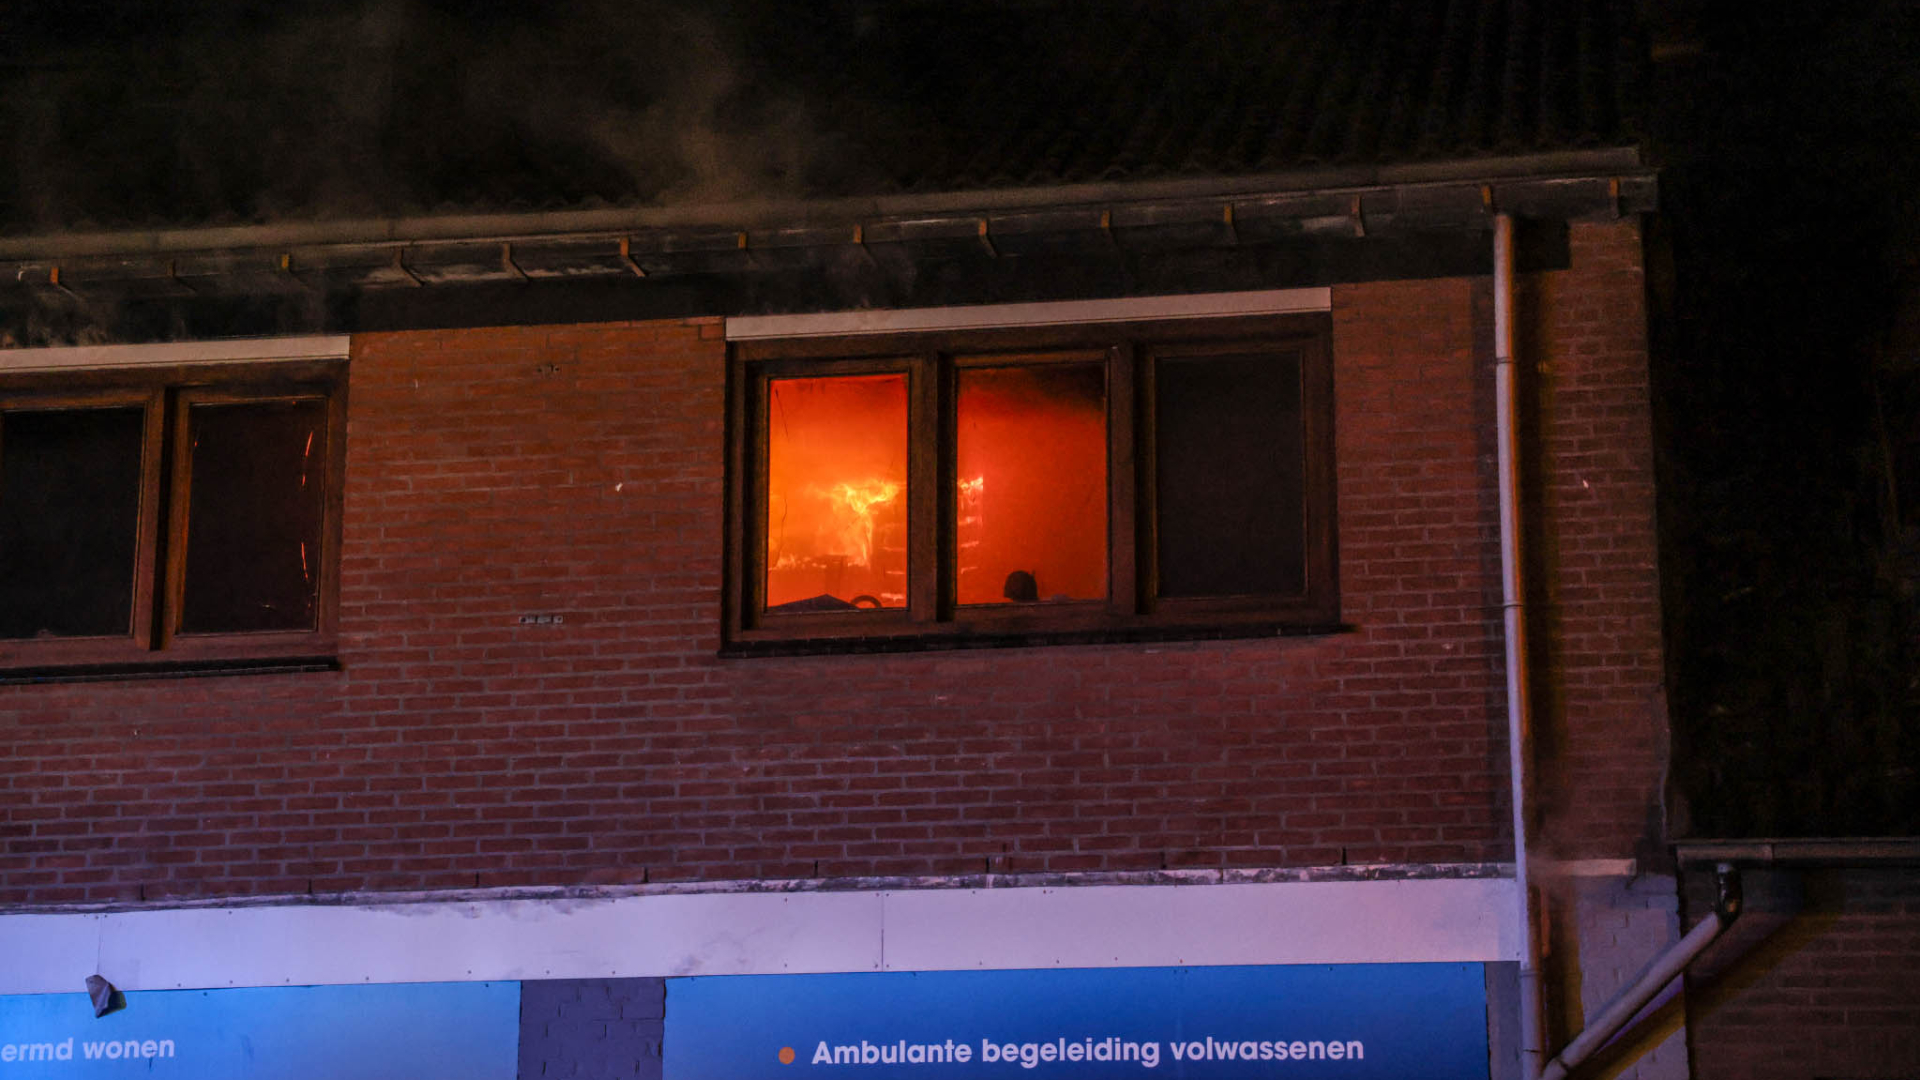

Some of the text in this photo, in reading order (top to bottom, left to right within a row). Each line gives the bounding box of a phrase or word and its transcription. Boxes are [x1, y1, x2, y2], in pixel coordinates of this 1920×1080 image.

[1, 1037, 176, 1062] ermd wonen
[811, 1036, 1365, 1069] Ambulante begeleiding volwassenen
